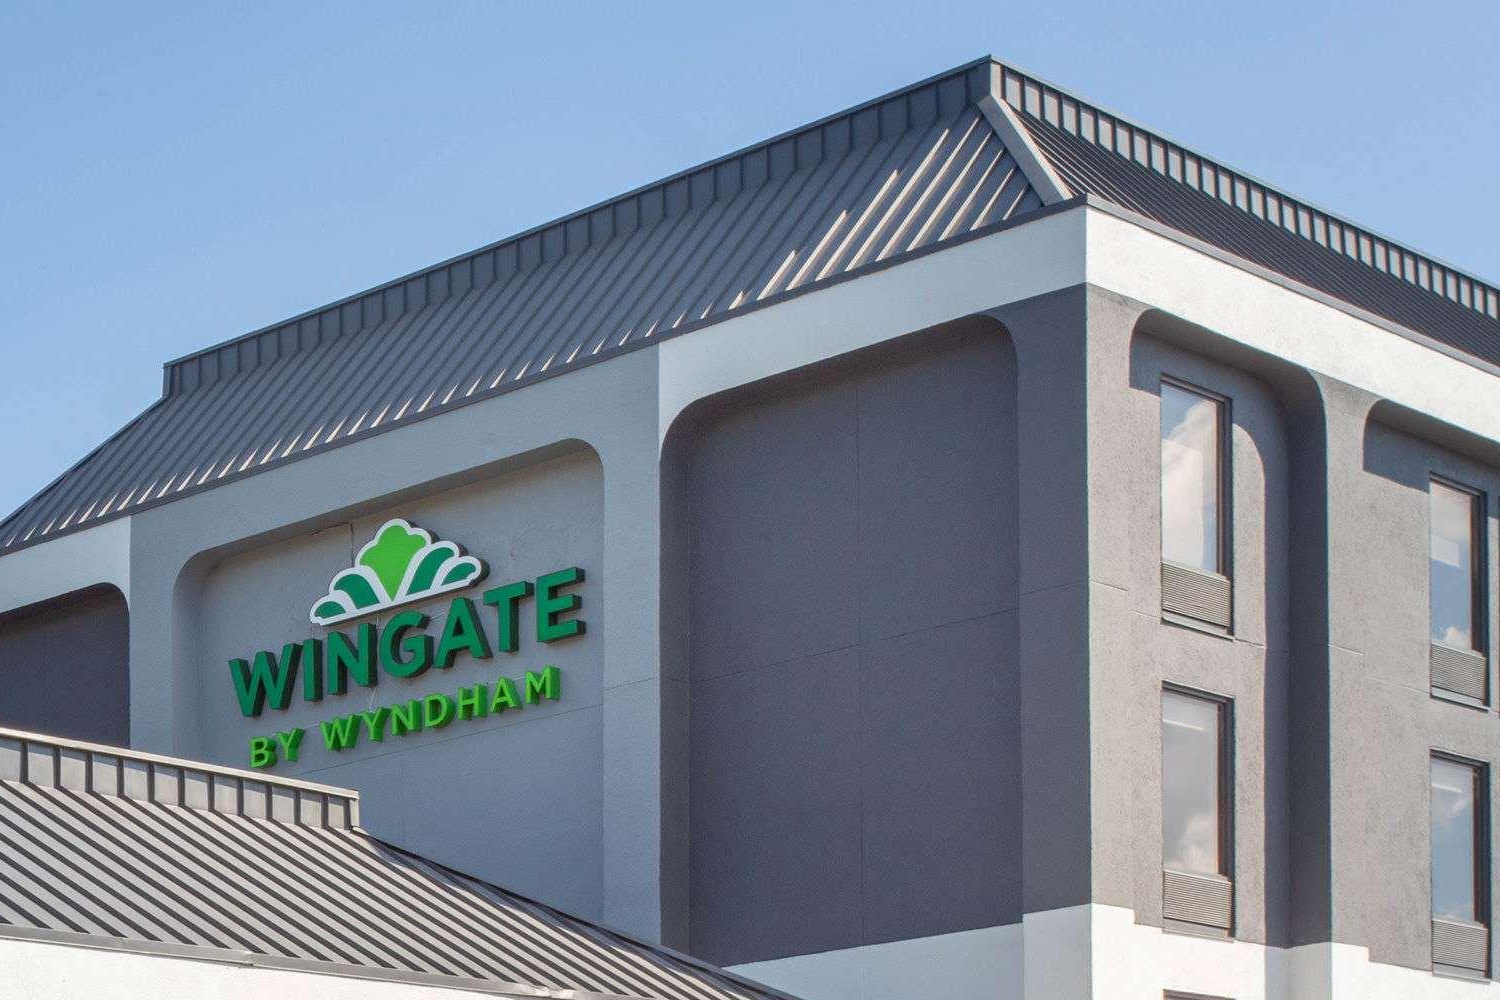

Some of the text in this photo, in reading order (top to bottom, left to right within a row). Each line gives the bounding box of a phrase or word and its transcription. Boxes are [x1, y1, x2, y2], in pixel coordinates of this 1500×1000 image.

[228, 566, 586, 718] WINGATE
[249, 664, 561, 770] BY WYNDHAM
